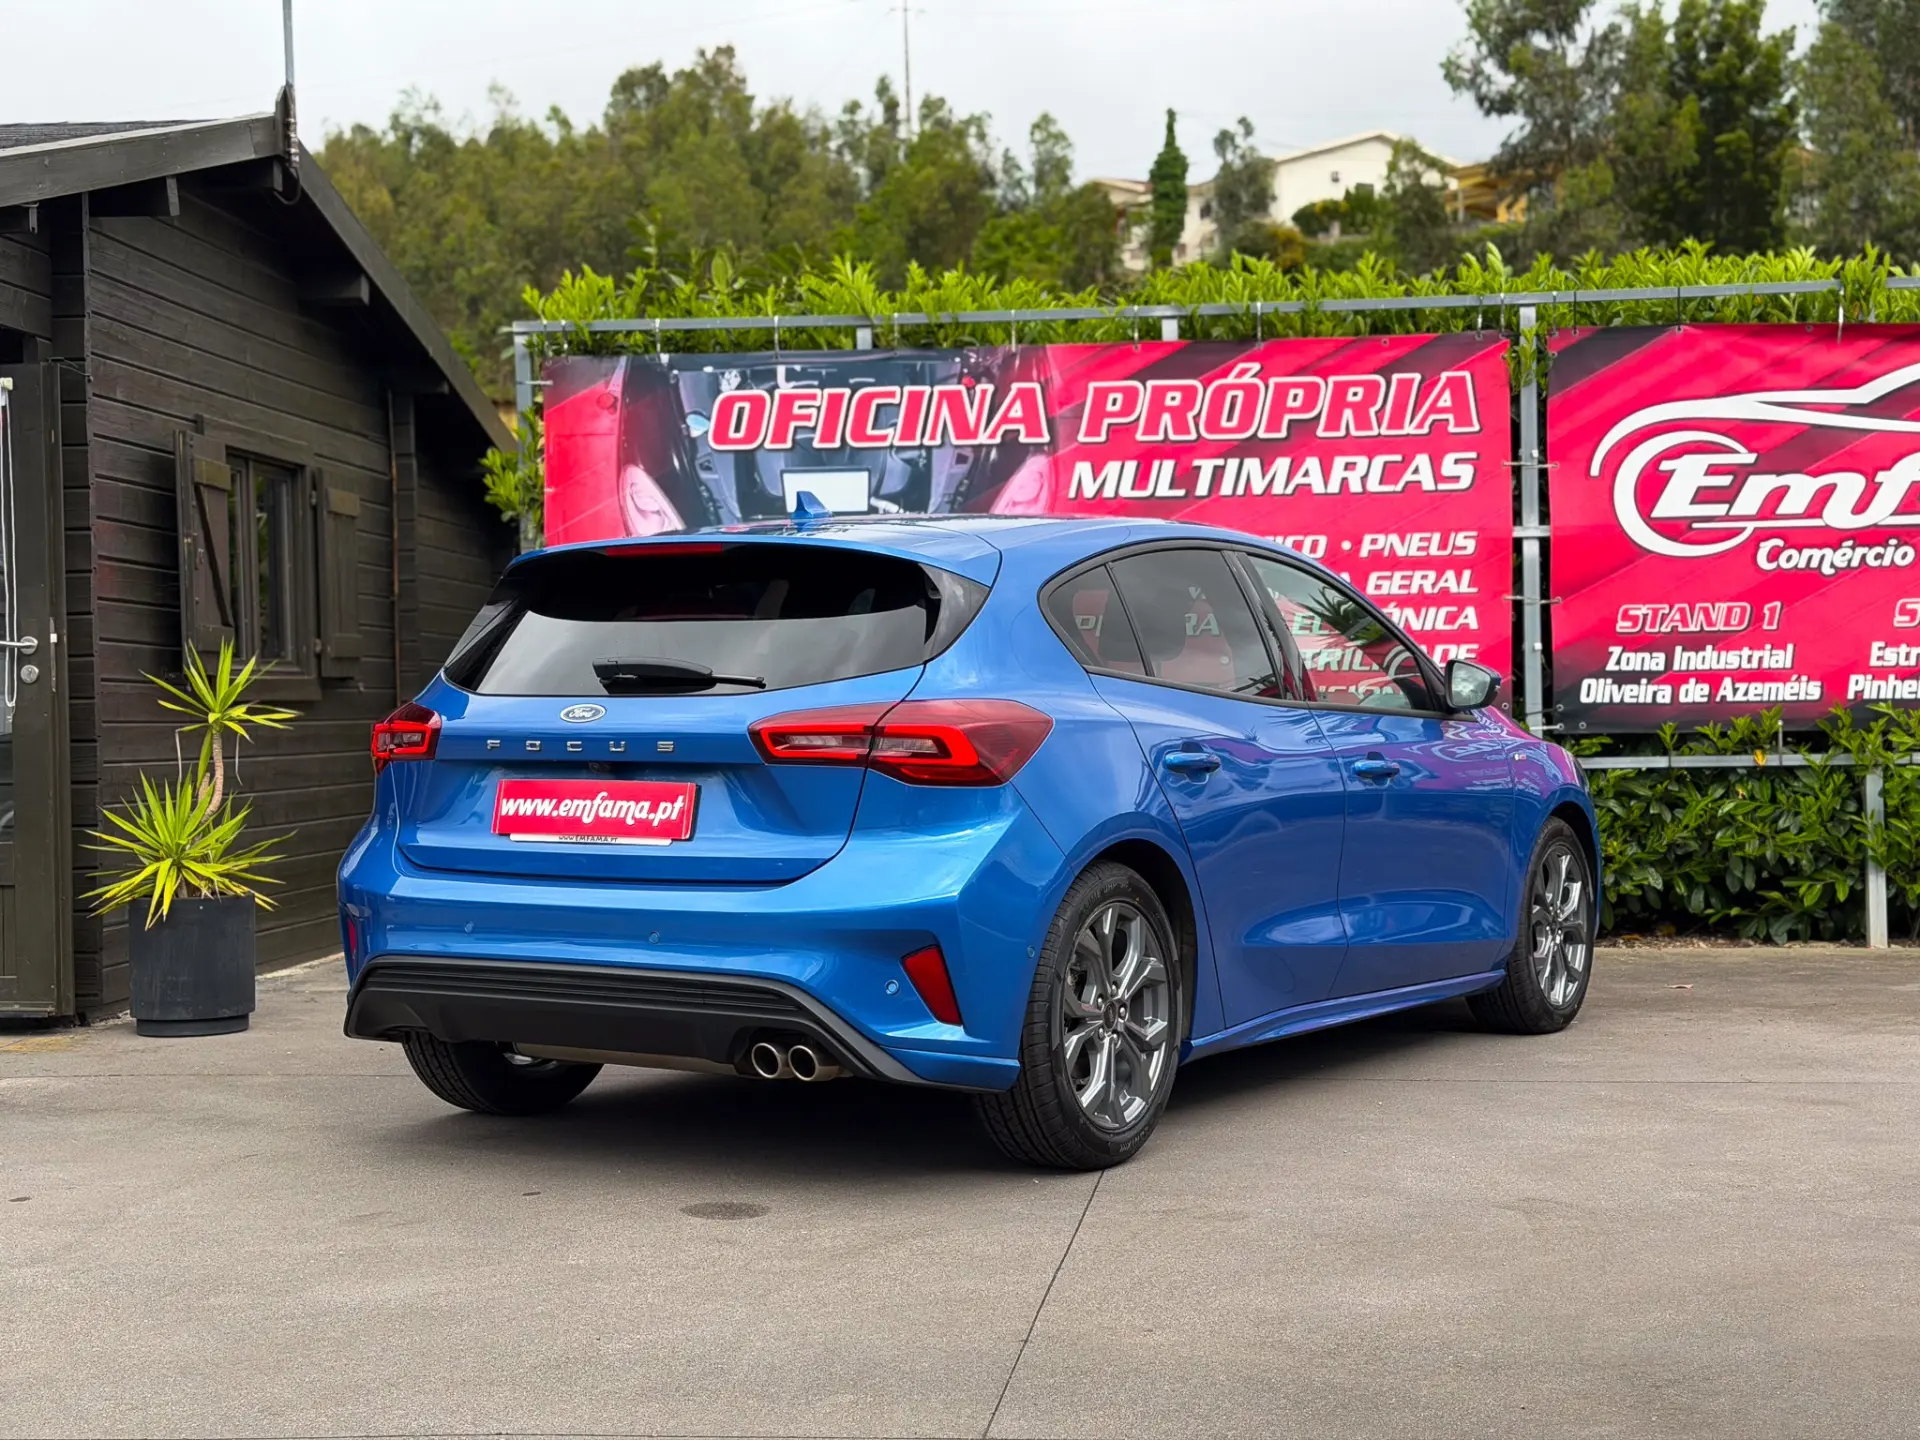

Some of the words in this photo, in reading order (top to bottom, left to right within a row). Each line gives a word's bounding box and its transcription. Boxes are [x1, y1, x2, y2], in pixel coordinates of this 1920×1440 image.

[707, 382, 1050, 451] OFICINA
[1077, 362, 1481, 443] PRÓPRIA
[1068, 452, 1478, 499] MULTIMARCAS
[1359, 531, 1478, 558] PNEUS
[1757, 539, 1915, 575] Comércio
[1366, 569, 1478, 595] GERAL
[1615, 602, 1752, 632] STAND
[1763, 601, 1783, 630] 1
[1605, 646, 1665, 671] Zona
[1673, 644, 1794, 670] Industrial
[1580, 678, 1672, 703] Oliveira
[1679, 677, 1710, 702] de
[1717, 676, 1822, 702] Azeméis
[1847, 674, 1920, 700] Pinhe
[487, 739, 674, 752] FOCUS
[501, 792, 684, 827] www.emfama.pt
